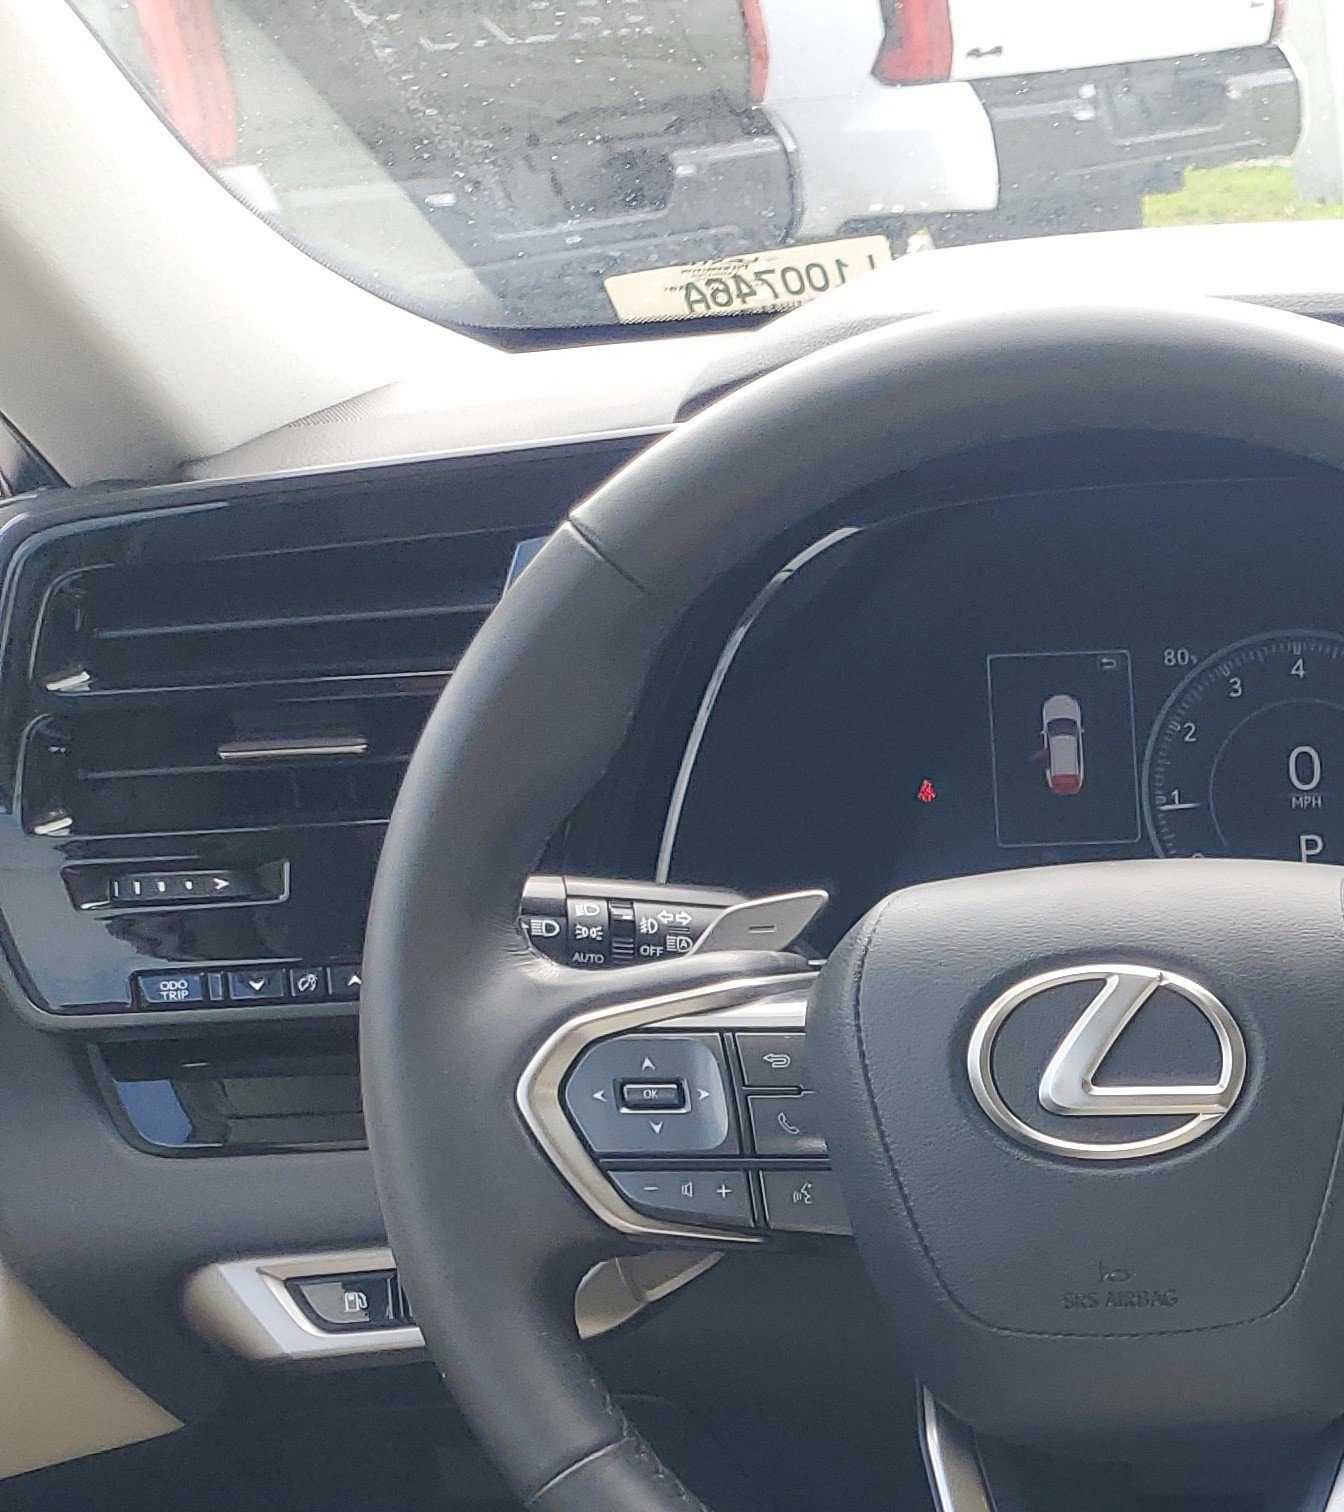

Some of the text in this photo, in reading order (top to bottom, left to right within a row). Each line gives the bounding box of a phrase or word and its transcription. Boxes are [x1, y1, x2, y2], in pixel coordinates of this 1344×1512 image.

[1290, 659, 1305, 678] 4
[1229, 678, 1242, 697] 3
[1183, 722, 1197, 742] 2
[1288, 746, 1322, 791] 0
[1170, 789, 1181, 804] 1
[1291, 795, 1322, 809] MPH
[1300, 834, 1323, 861] P
[640, 945, 664, 957] OFF
[572, 953, 604, 964] AUTO
[159, 980, 188, 990] ODO
[159, 990, 189, 1001] TRIP
[643, 1089, 659, 1099] OK
